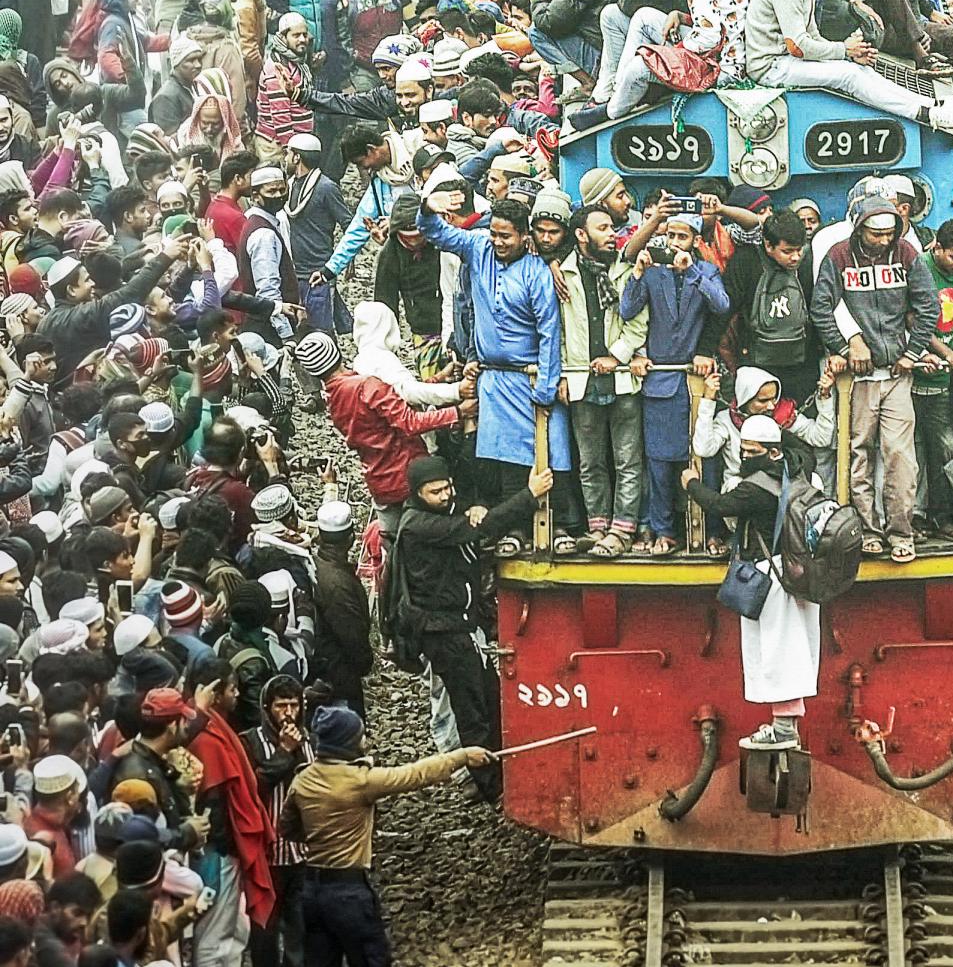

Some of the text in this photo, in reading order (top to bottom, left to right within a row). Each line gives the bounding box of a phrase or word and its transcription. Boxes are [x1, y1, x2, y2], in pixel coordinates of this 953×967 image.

[629, 134, 700, 162] ২৯১৭
[817, 129, 890, 157] 2917
[518, 682, 588, 709] ২৯১৭
